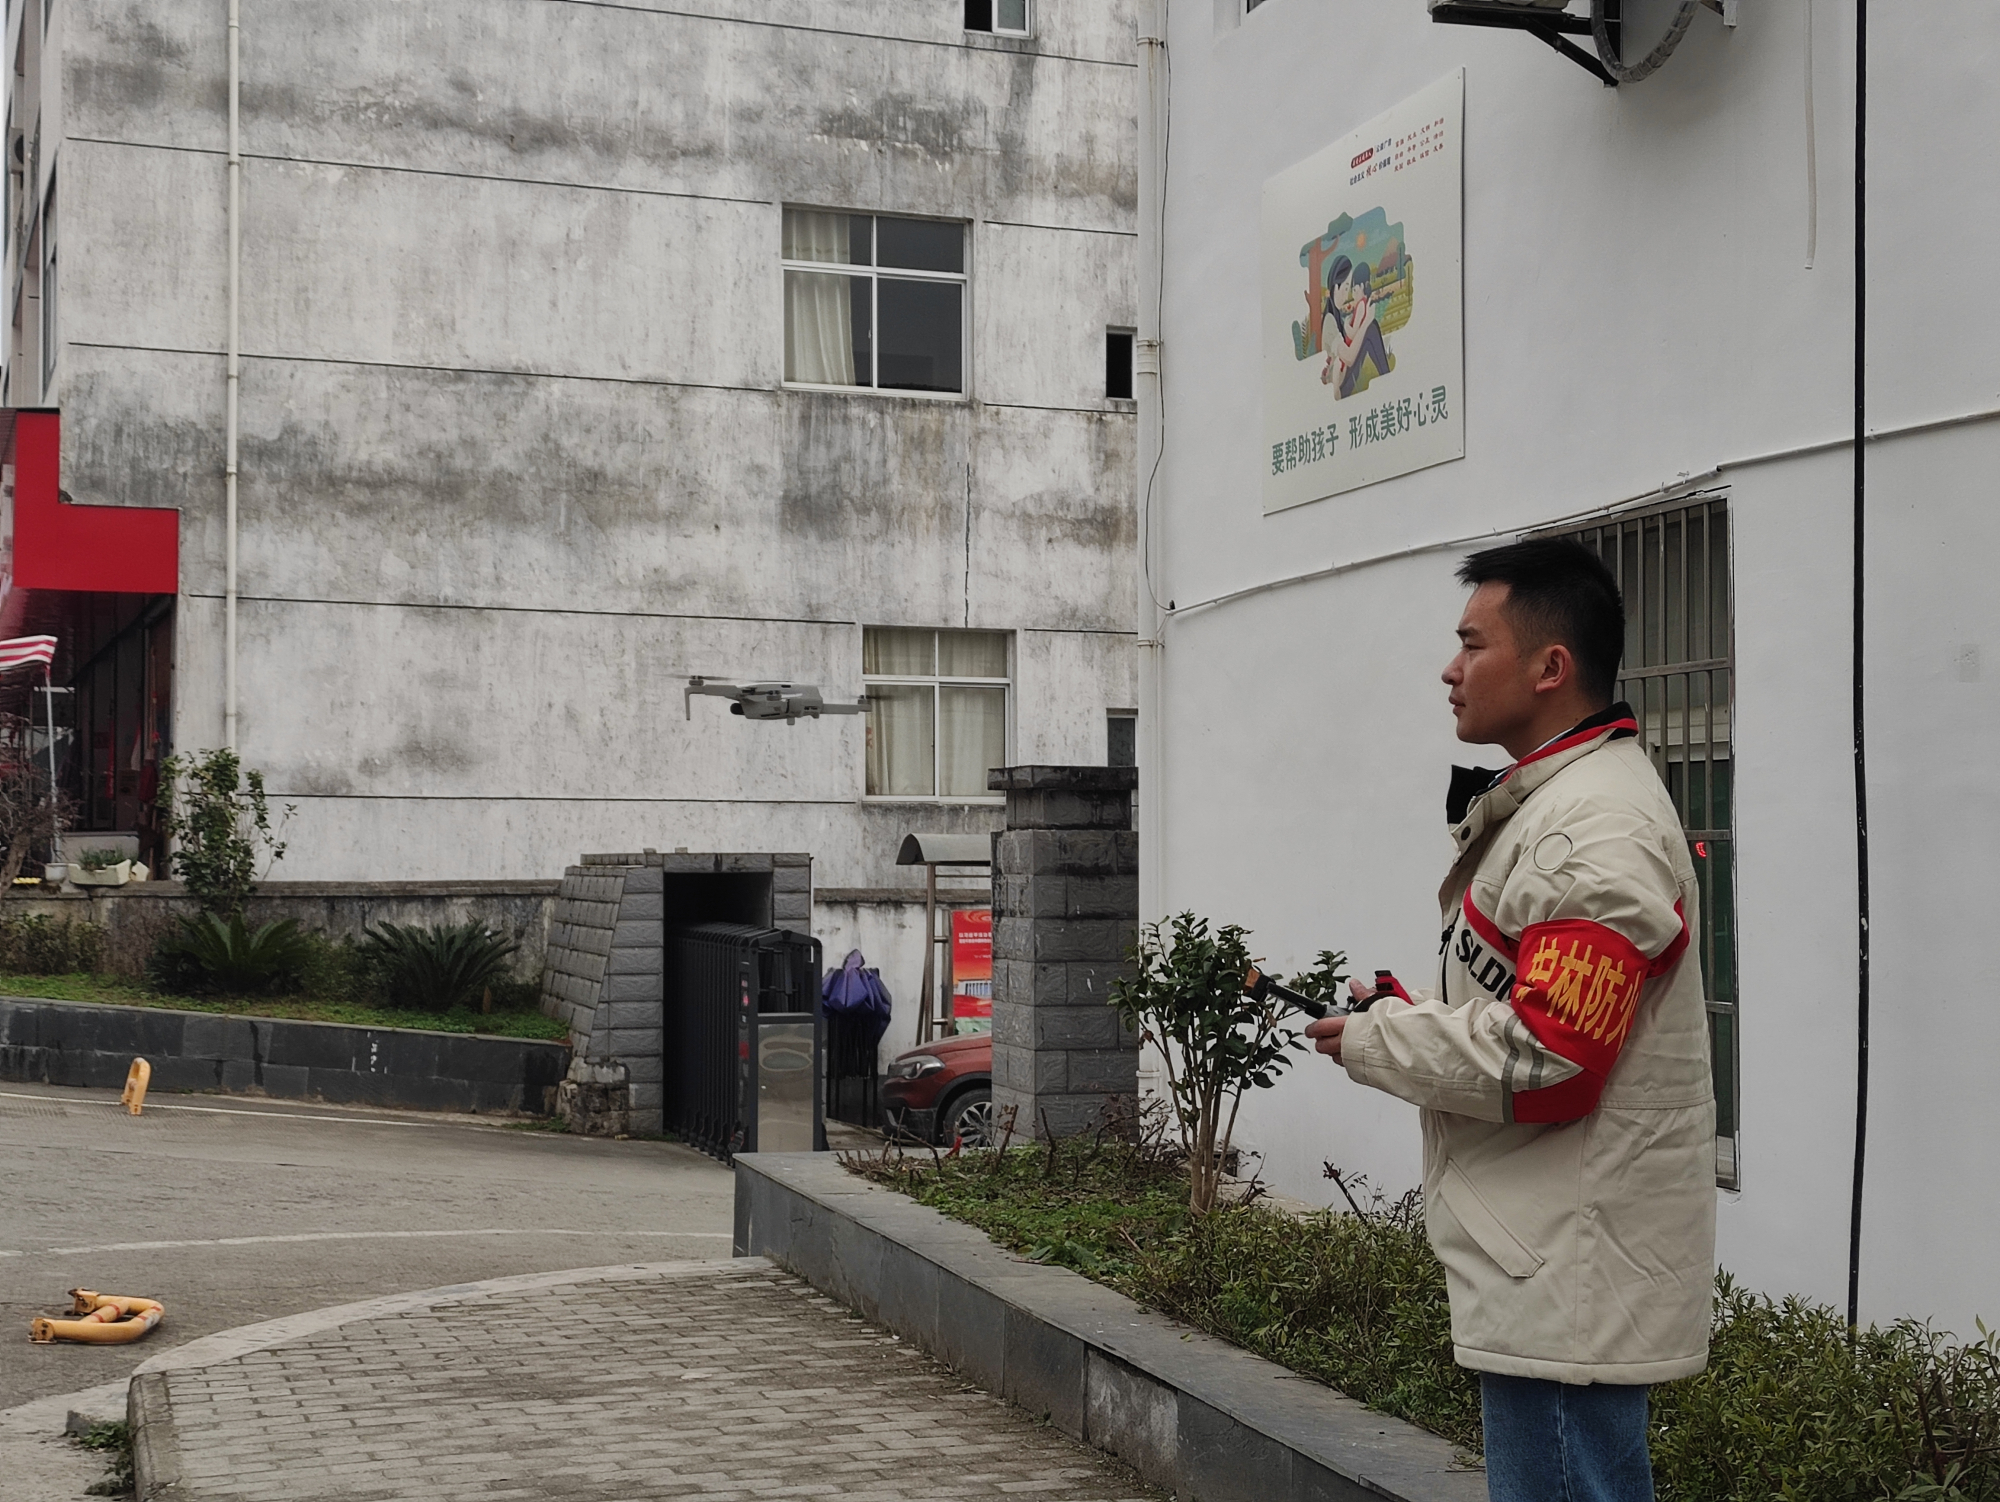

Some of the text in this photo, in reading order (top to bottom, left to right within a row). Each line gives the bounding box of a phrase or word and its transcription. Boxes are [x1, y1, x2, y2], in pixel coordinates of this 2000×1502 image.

[1271, 384, 1449, 476] 要帮助孩子 形成美好心灵
